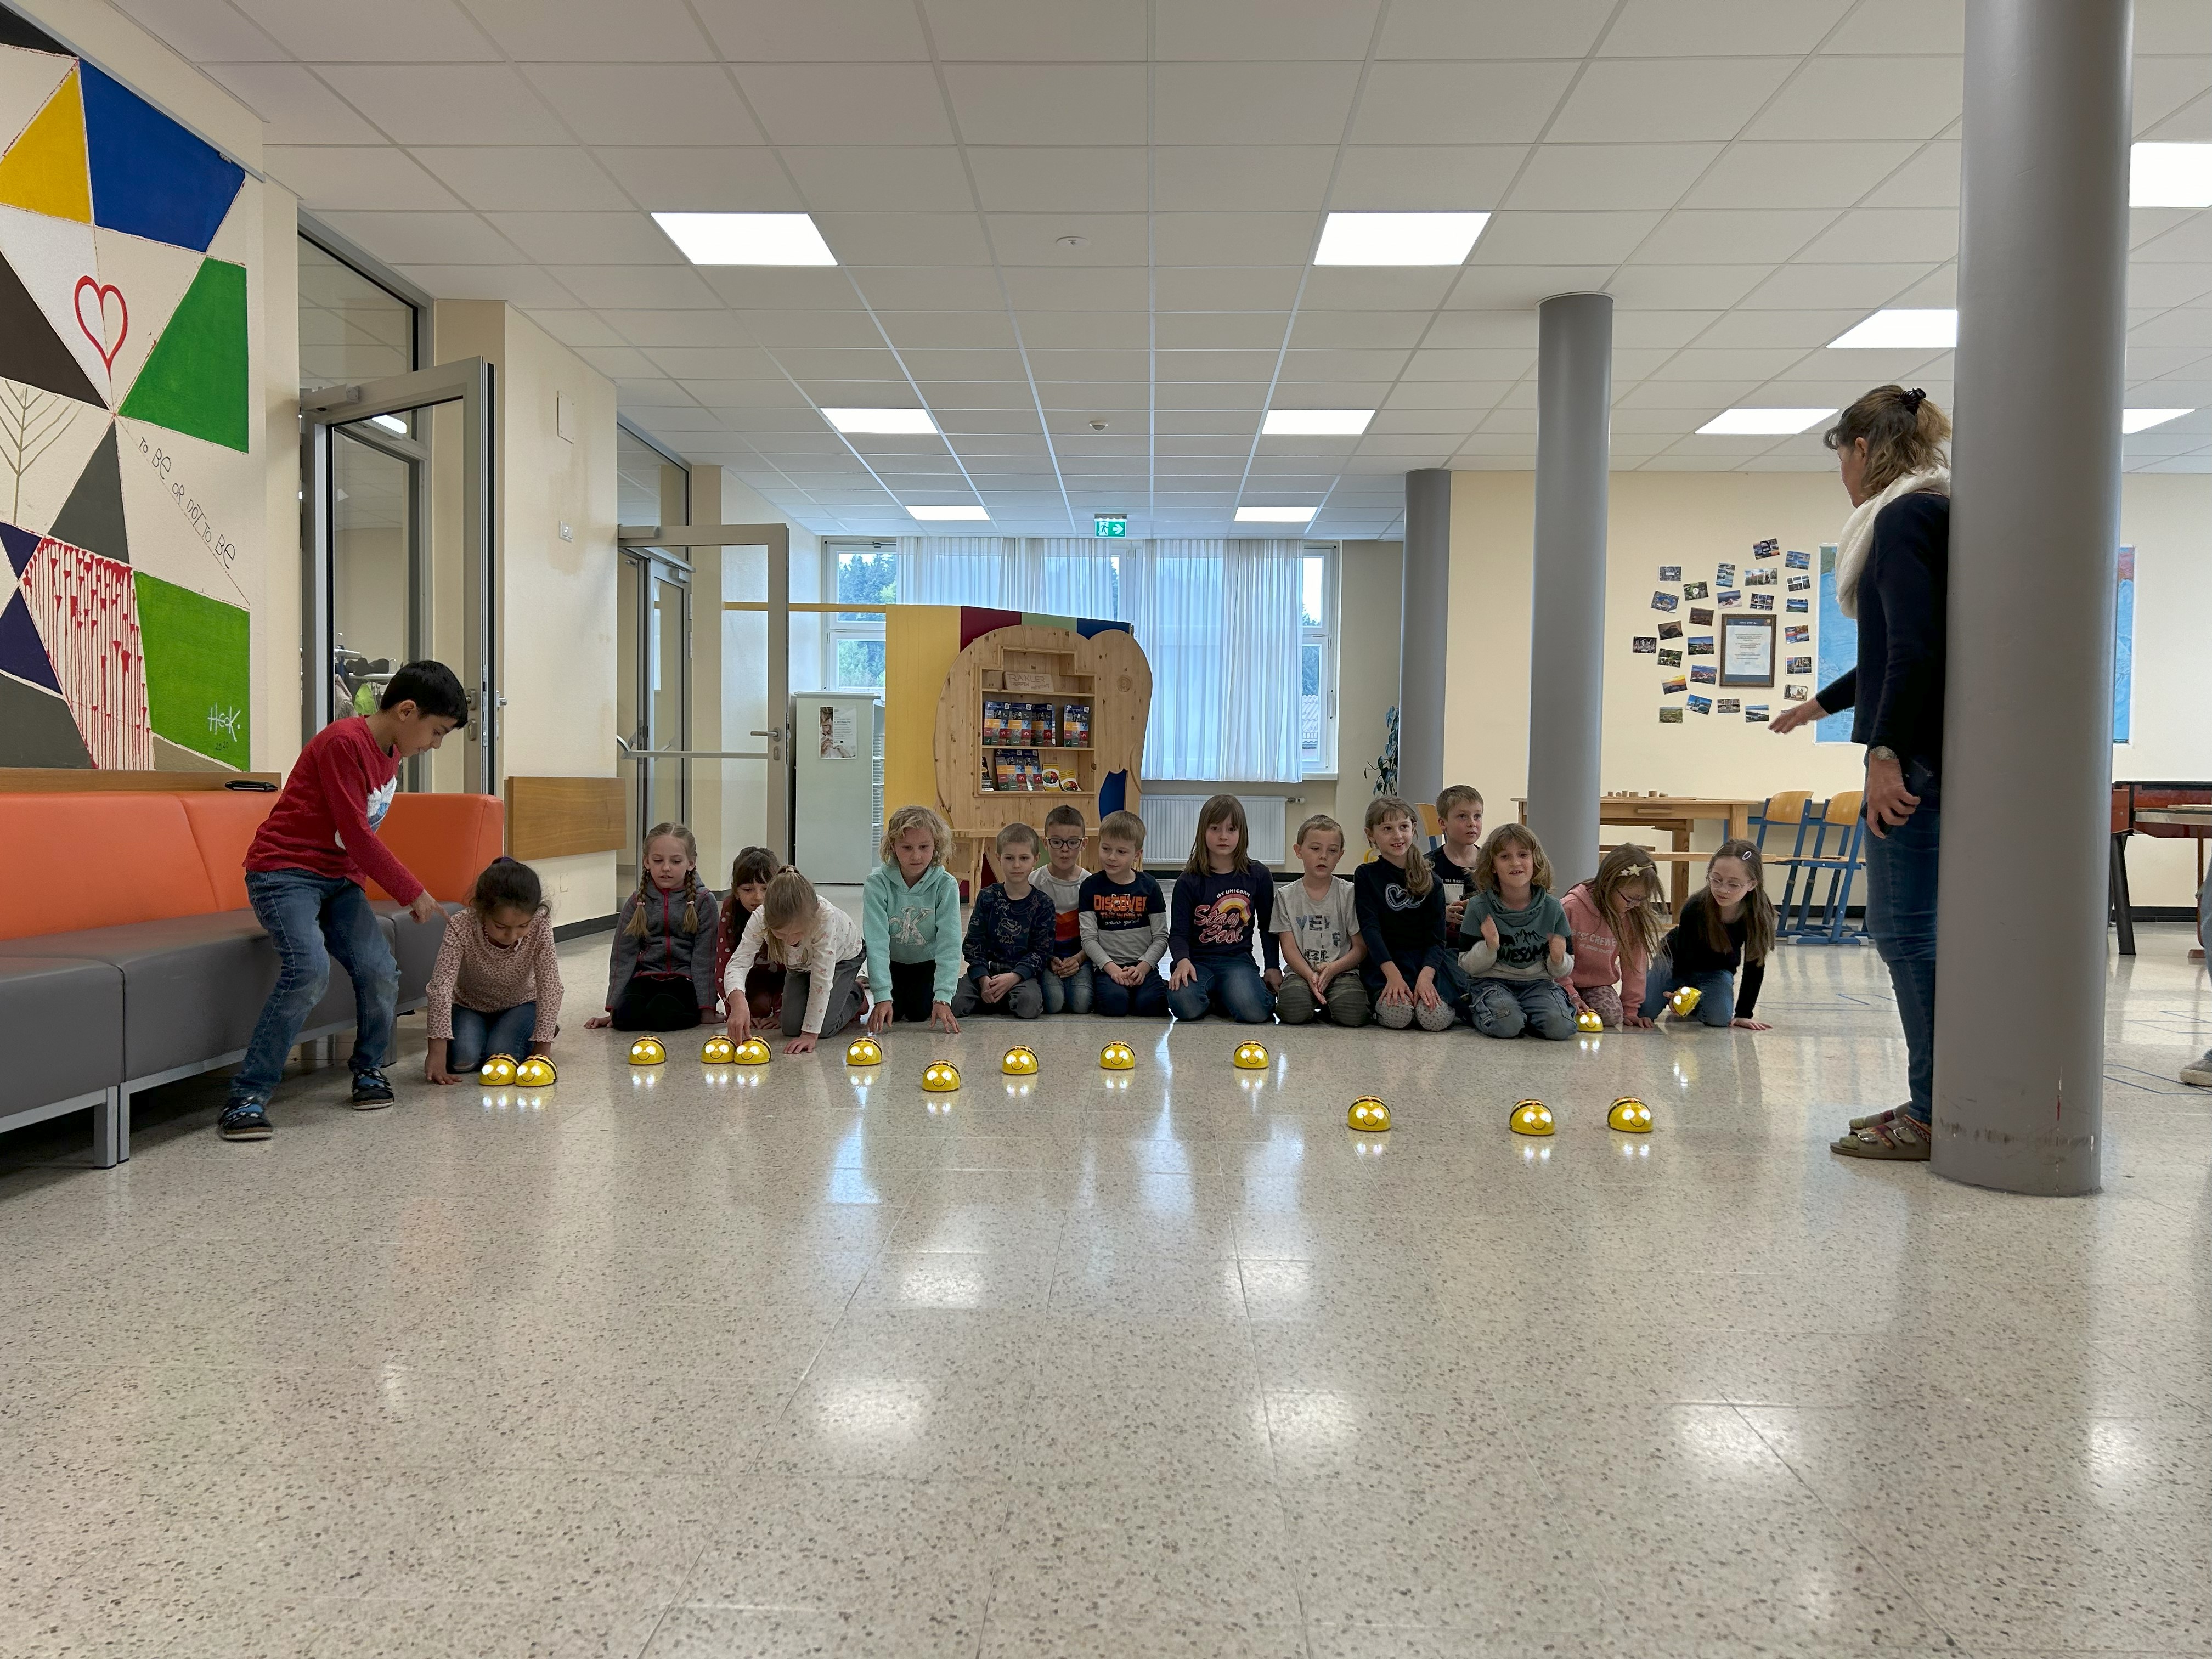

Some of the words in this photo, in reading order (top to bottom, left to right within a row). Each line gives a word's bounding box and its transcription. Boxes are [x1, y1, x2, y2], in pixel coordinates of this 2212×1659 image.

[215, 741, 229, 751] 2020
[1225, 889, 1251, 898] UNICORN
[1194, 904, 1240, 928] Stay
[1199, 924, 1243, 944] Cool
